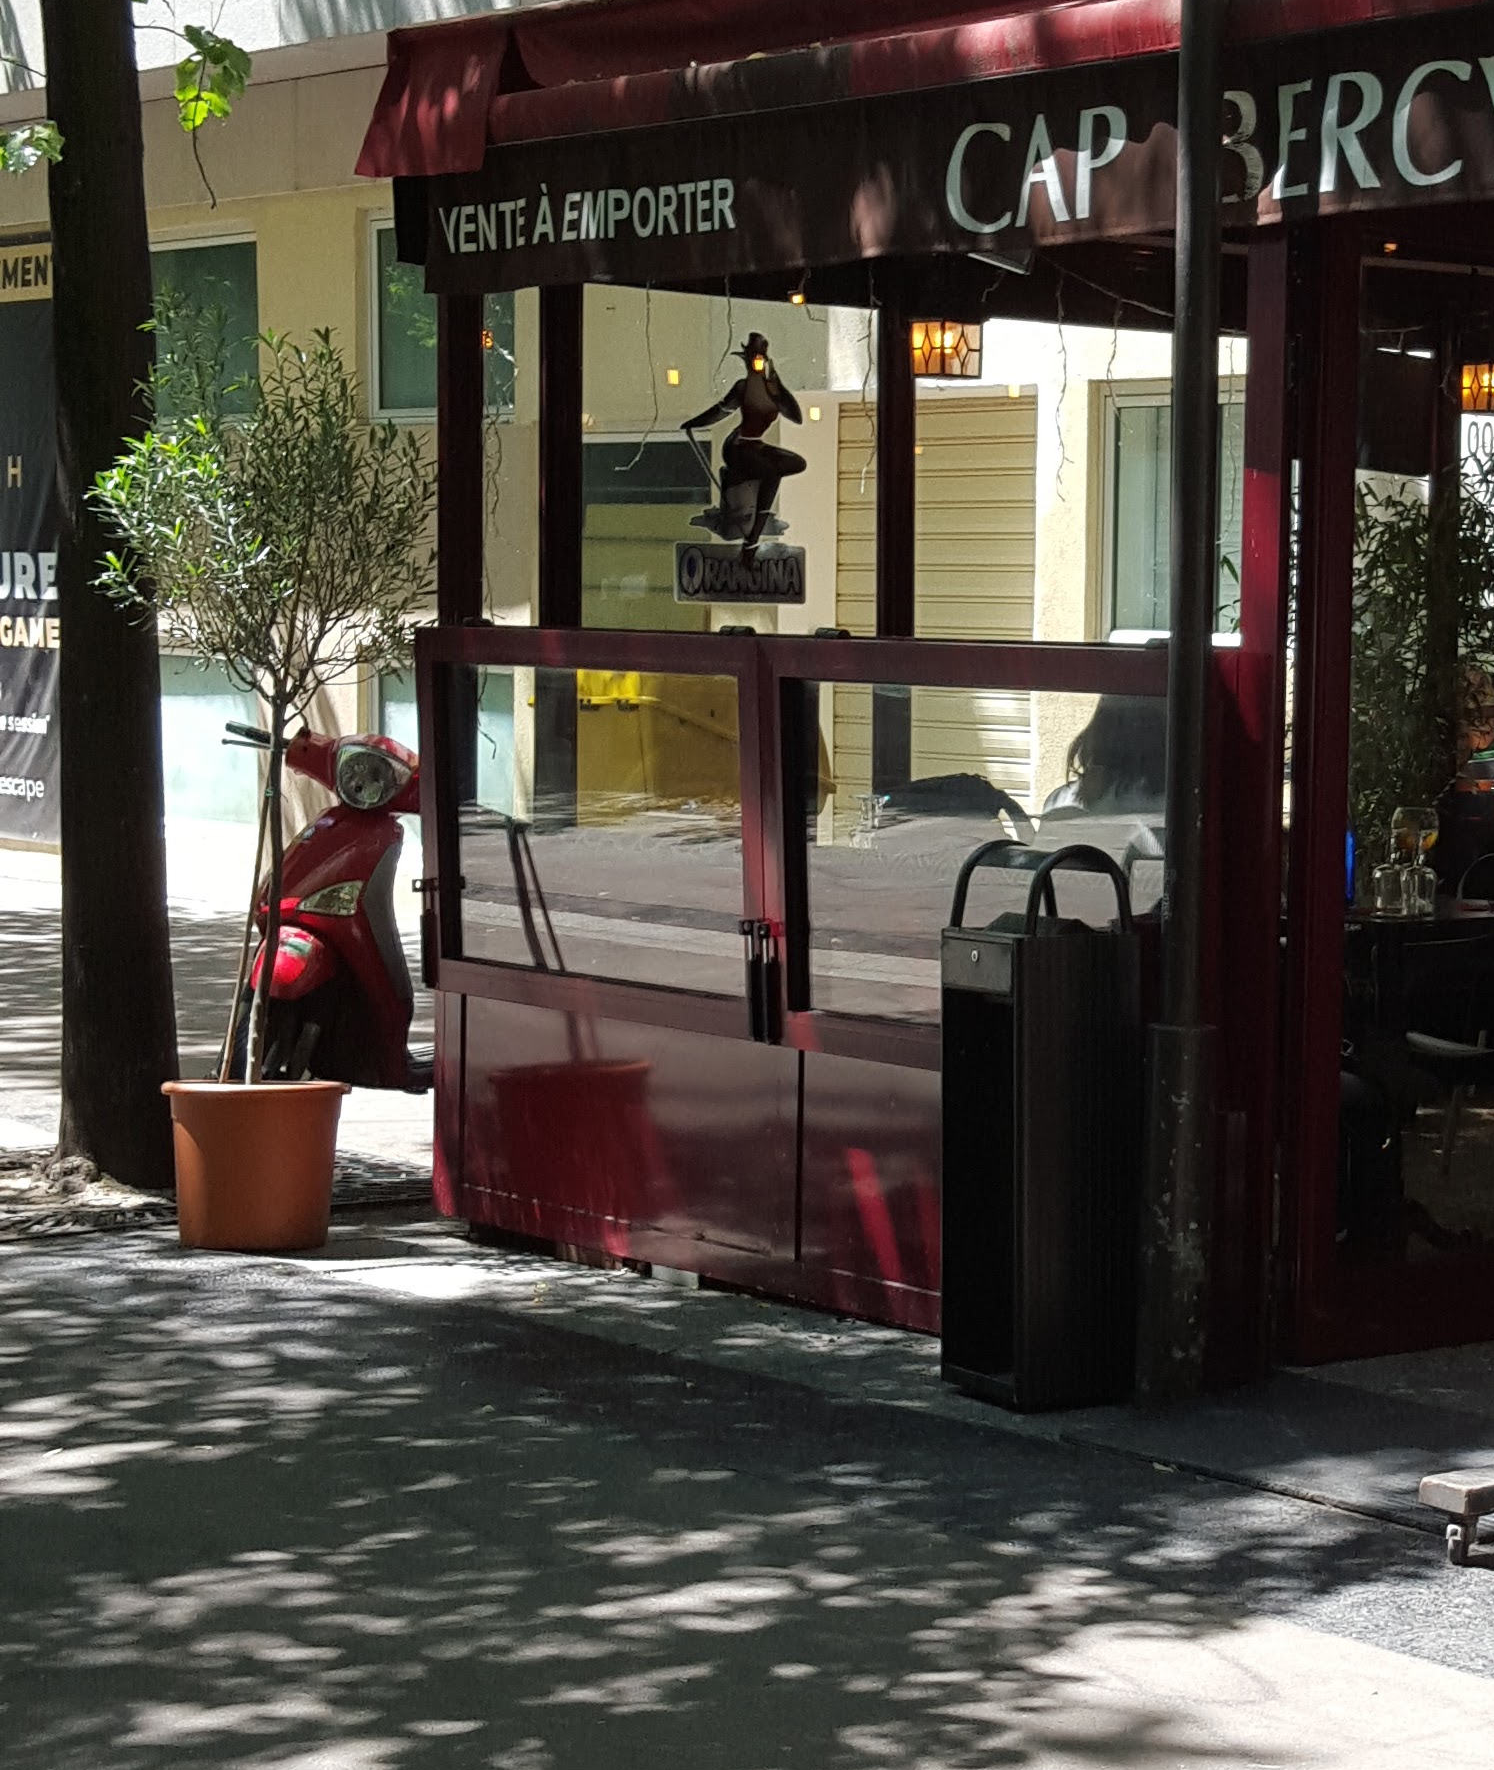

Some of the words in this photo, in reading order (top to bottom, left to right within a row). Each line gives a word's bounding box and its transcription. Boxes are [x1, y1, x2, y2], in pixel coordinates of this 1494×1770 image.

[946, 105, 1127, 234] CAP
[438, 197, 527, 254] VENTE
[532, 182, 555, 245] À
[561, 178, 736, 241] EMPORTER
[0, 617, 60, 649] GAME
